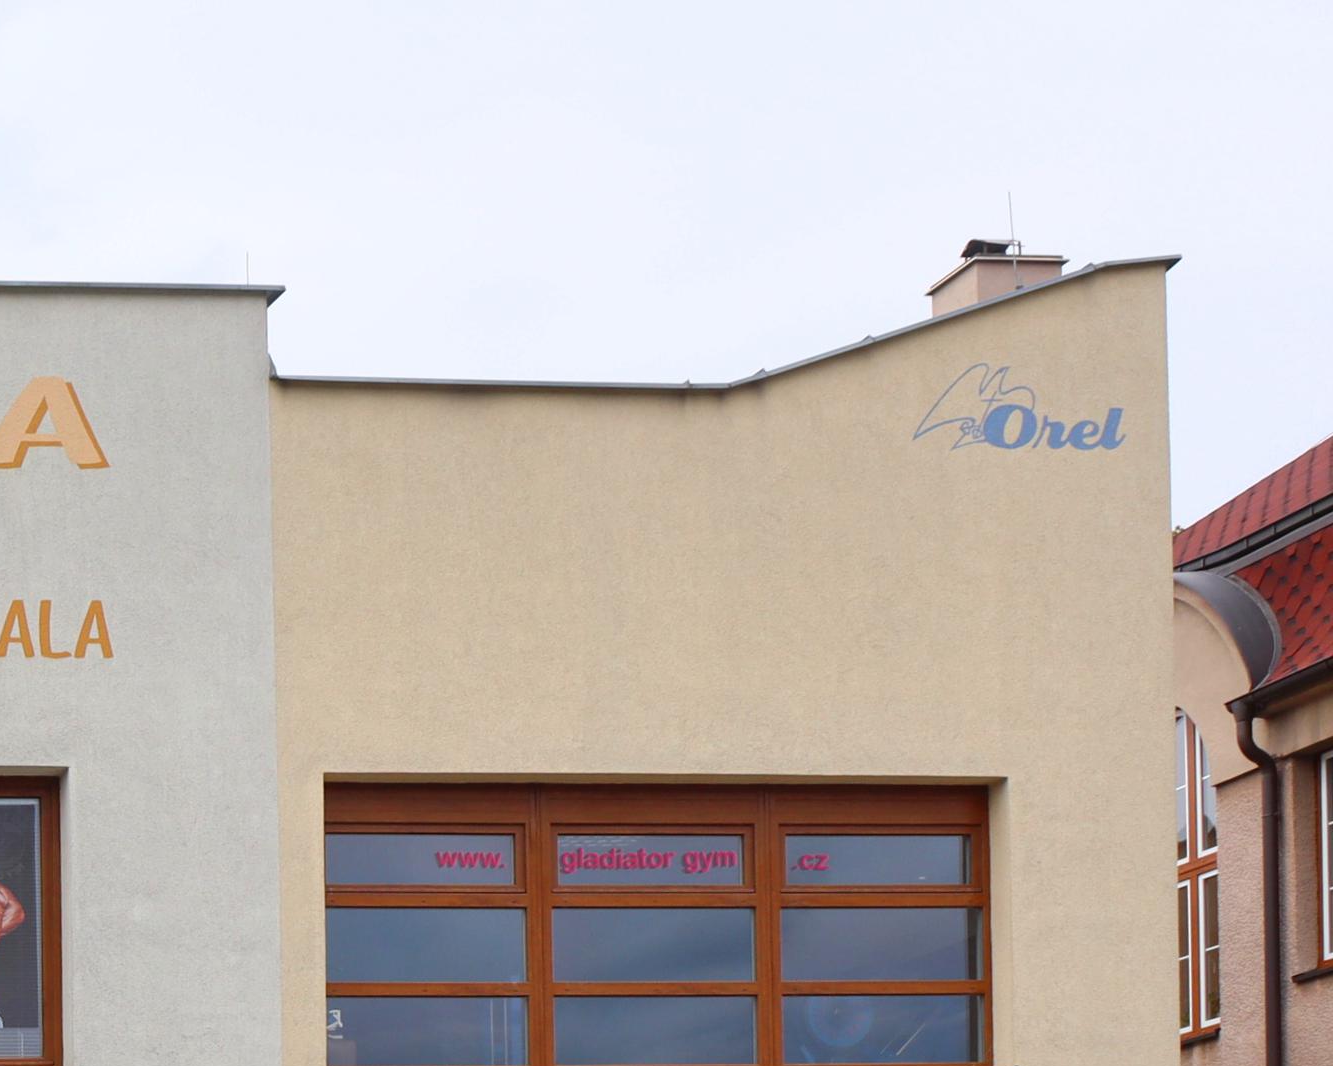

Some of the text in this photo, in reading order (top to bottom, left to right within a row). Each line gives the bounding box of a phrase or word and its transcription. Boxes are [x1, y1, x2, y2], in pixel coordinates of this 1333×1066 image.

[983, 404, 1126, 450] Orel
[435, 848, 830, 874] www. gladiator gym .cz
